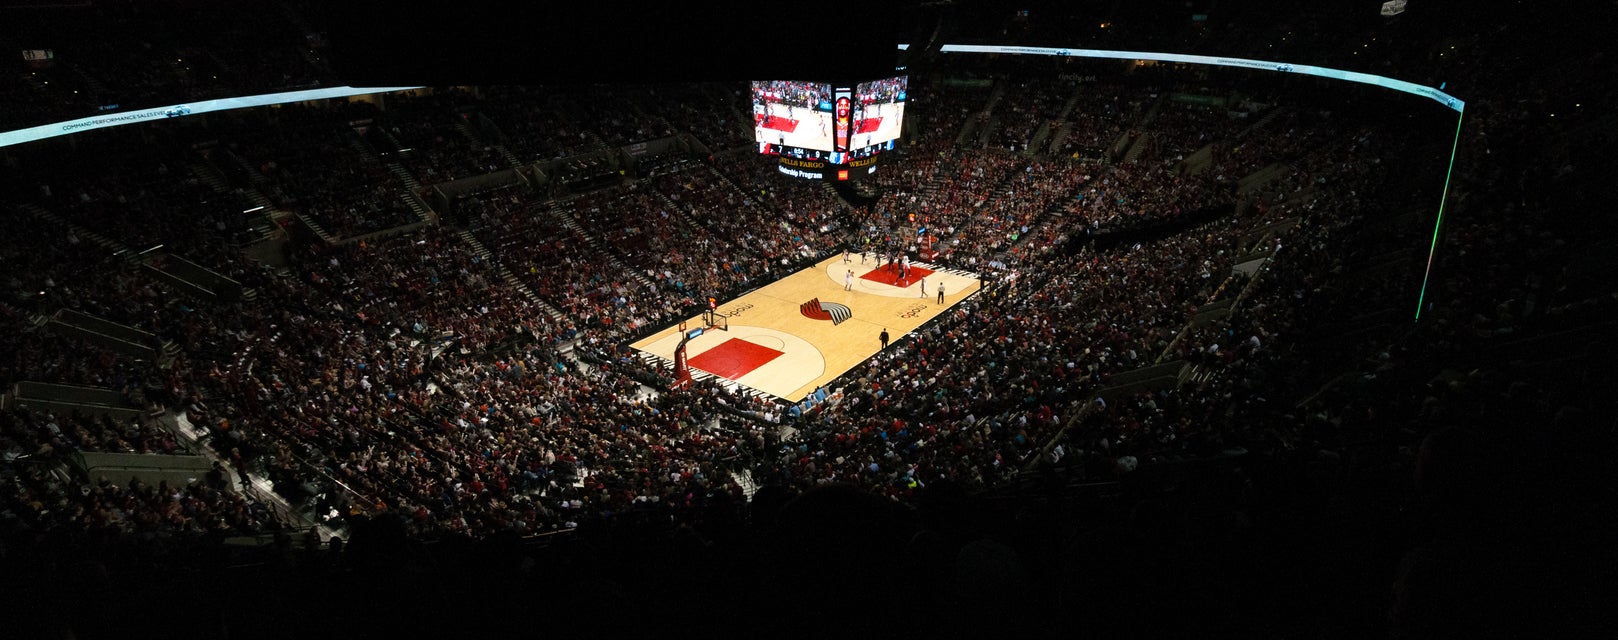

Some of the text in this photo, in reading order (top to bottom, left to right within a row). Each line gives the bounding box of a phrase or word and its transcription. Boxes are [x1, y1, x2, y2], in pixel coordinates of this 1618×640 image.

[62, 121, 92, 131] COMMAND
[92, 114, 136, 126] PERFORMANCE
[799, 160, 825, 169] FARGO
[799, 170, 823, 179] Program
